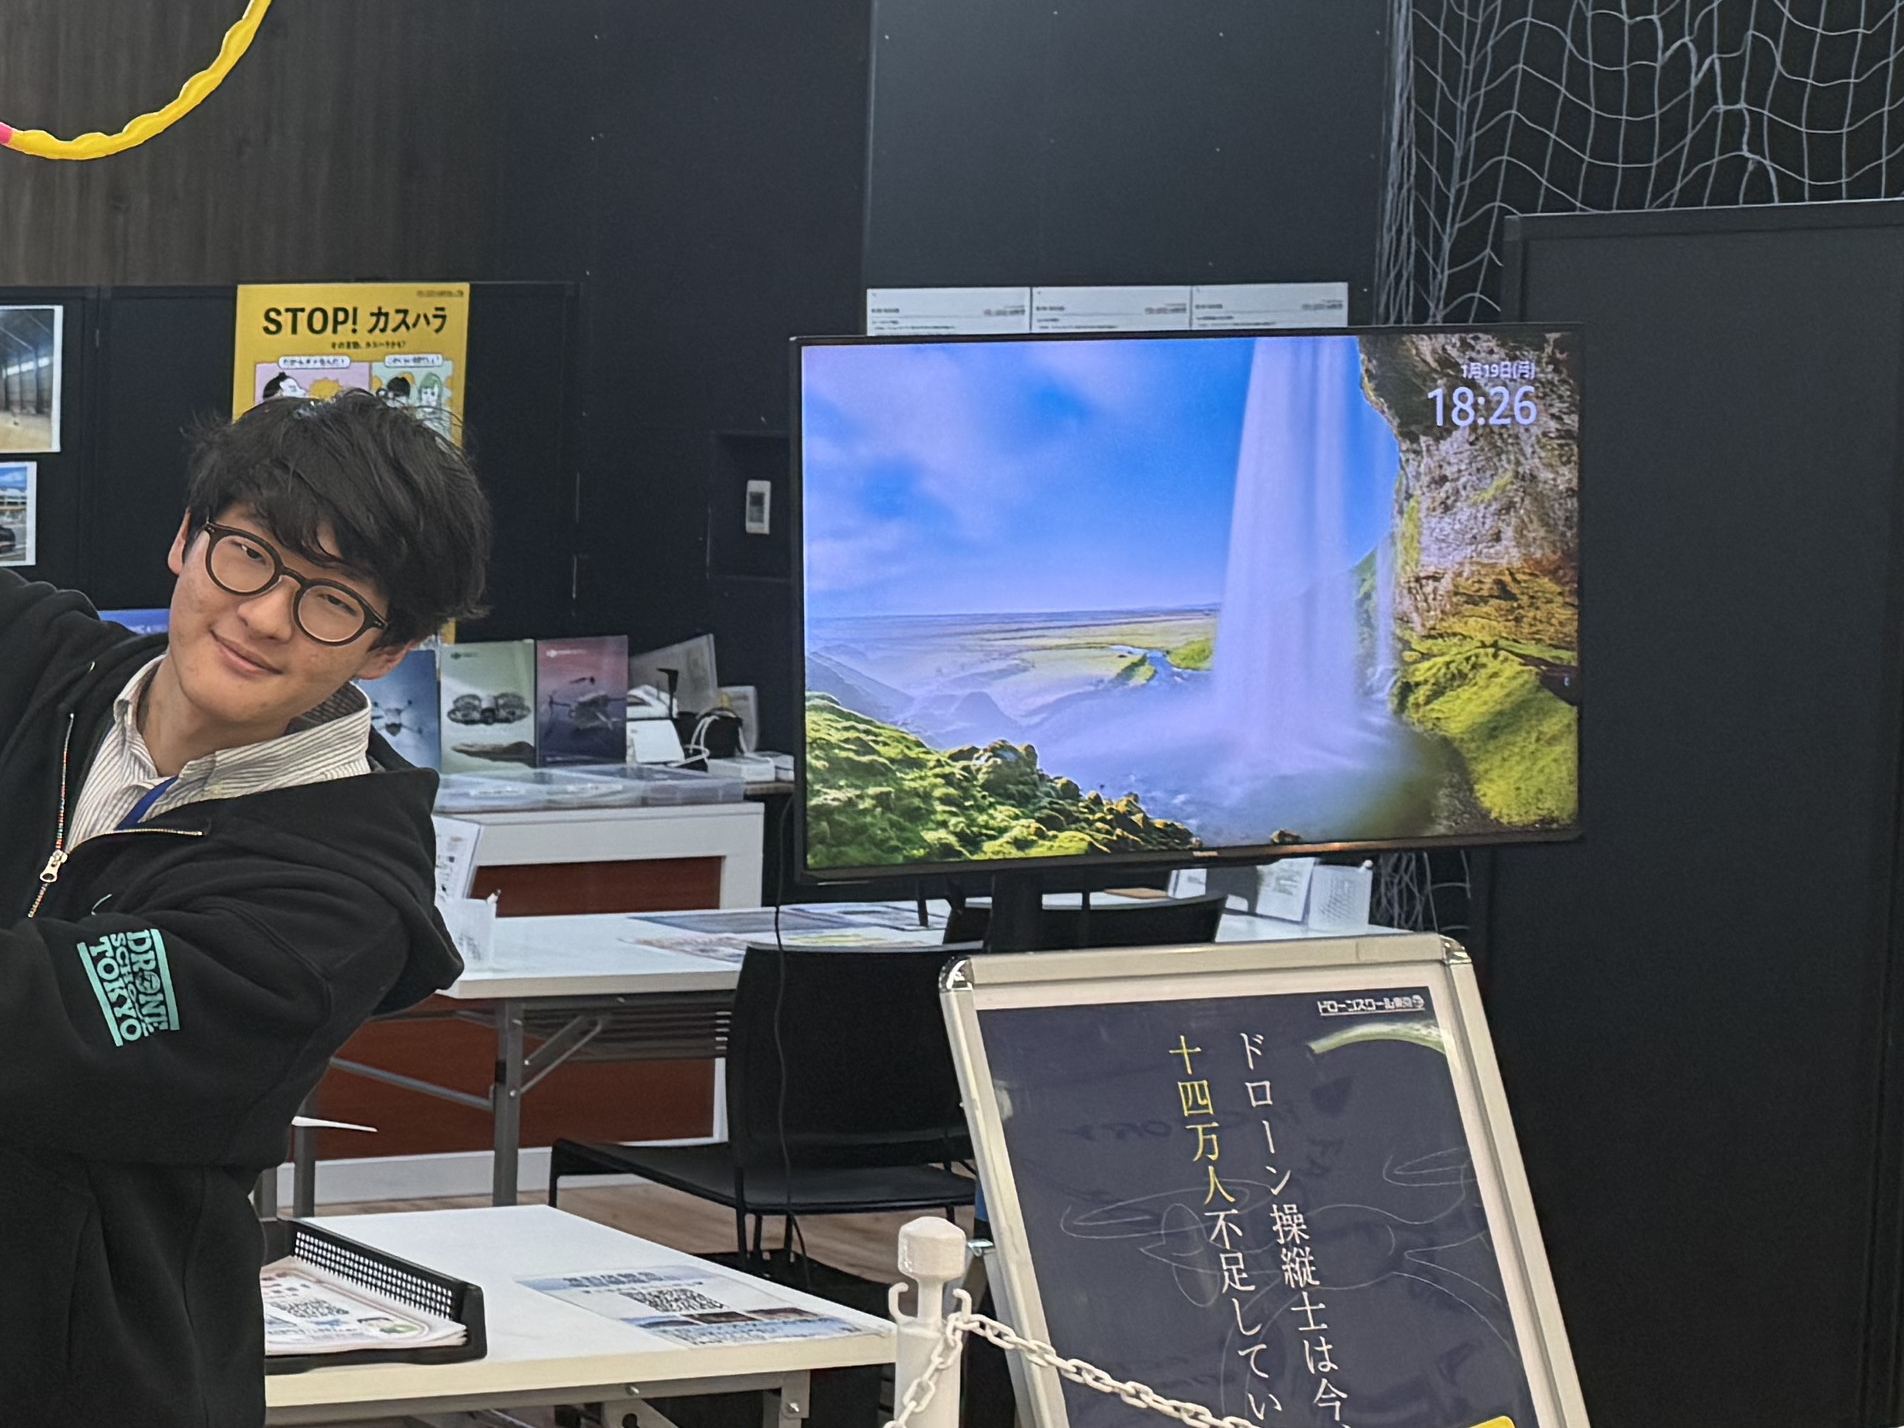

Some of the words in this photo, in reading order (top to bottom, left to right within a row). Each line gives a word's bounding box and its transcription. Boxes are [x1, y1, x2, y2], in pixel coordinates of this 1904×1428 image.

[262, 307, 358, 335] STOP!
[367, 306, 448, 334] カスハラ
[1427, 385, 1537, 427] 18:26
[89, 935, 142, 1042] TOKYO
